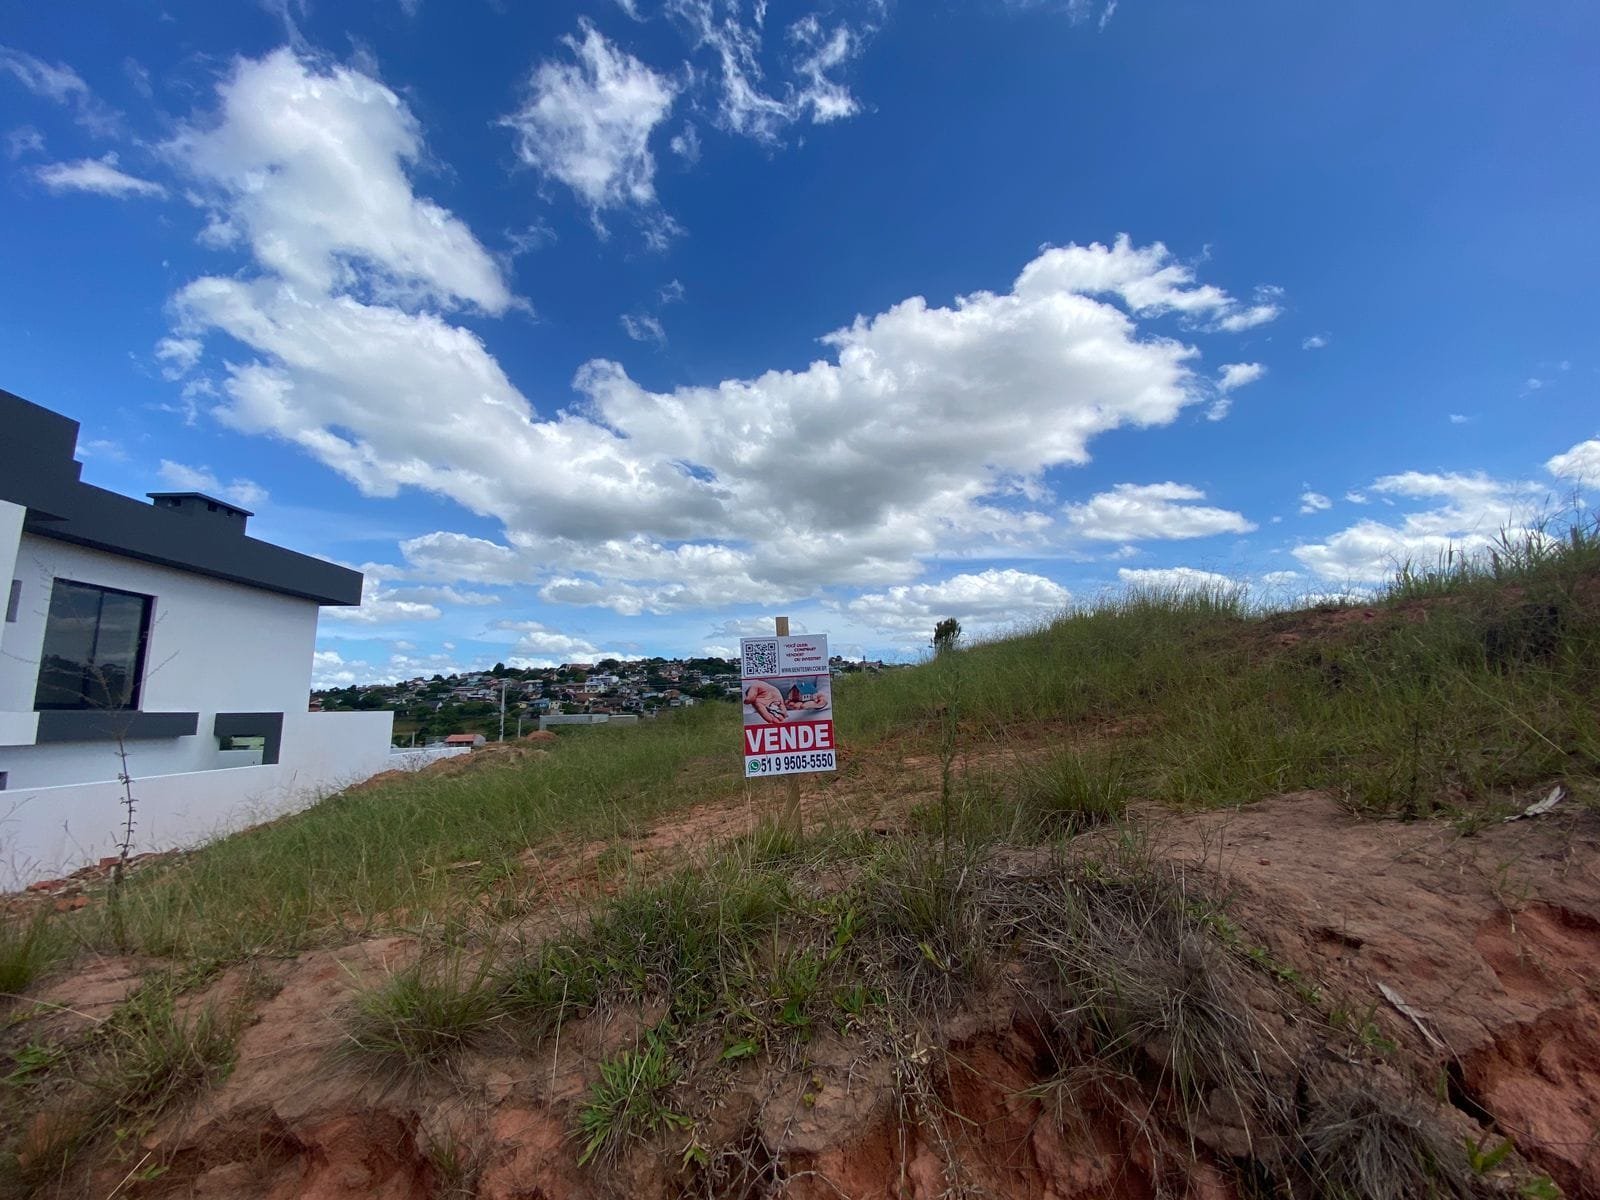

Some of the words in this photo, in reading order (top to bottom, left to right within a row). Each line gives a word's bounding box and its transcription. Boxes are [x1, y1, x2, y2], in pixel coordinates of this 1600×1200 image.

[745, 724, 830, 752] VENDE
[761, 757, 772, 772] 51
[775, 757, 781, 771] 9
[784, 753, 833, 770] 9505-5550
